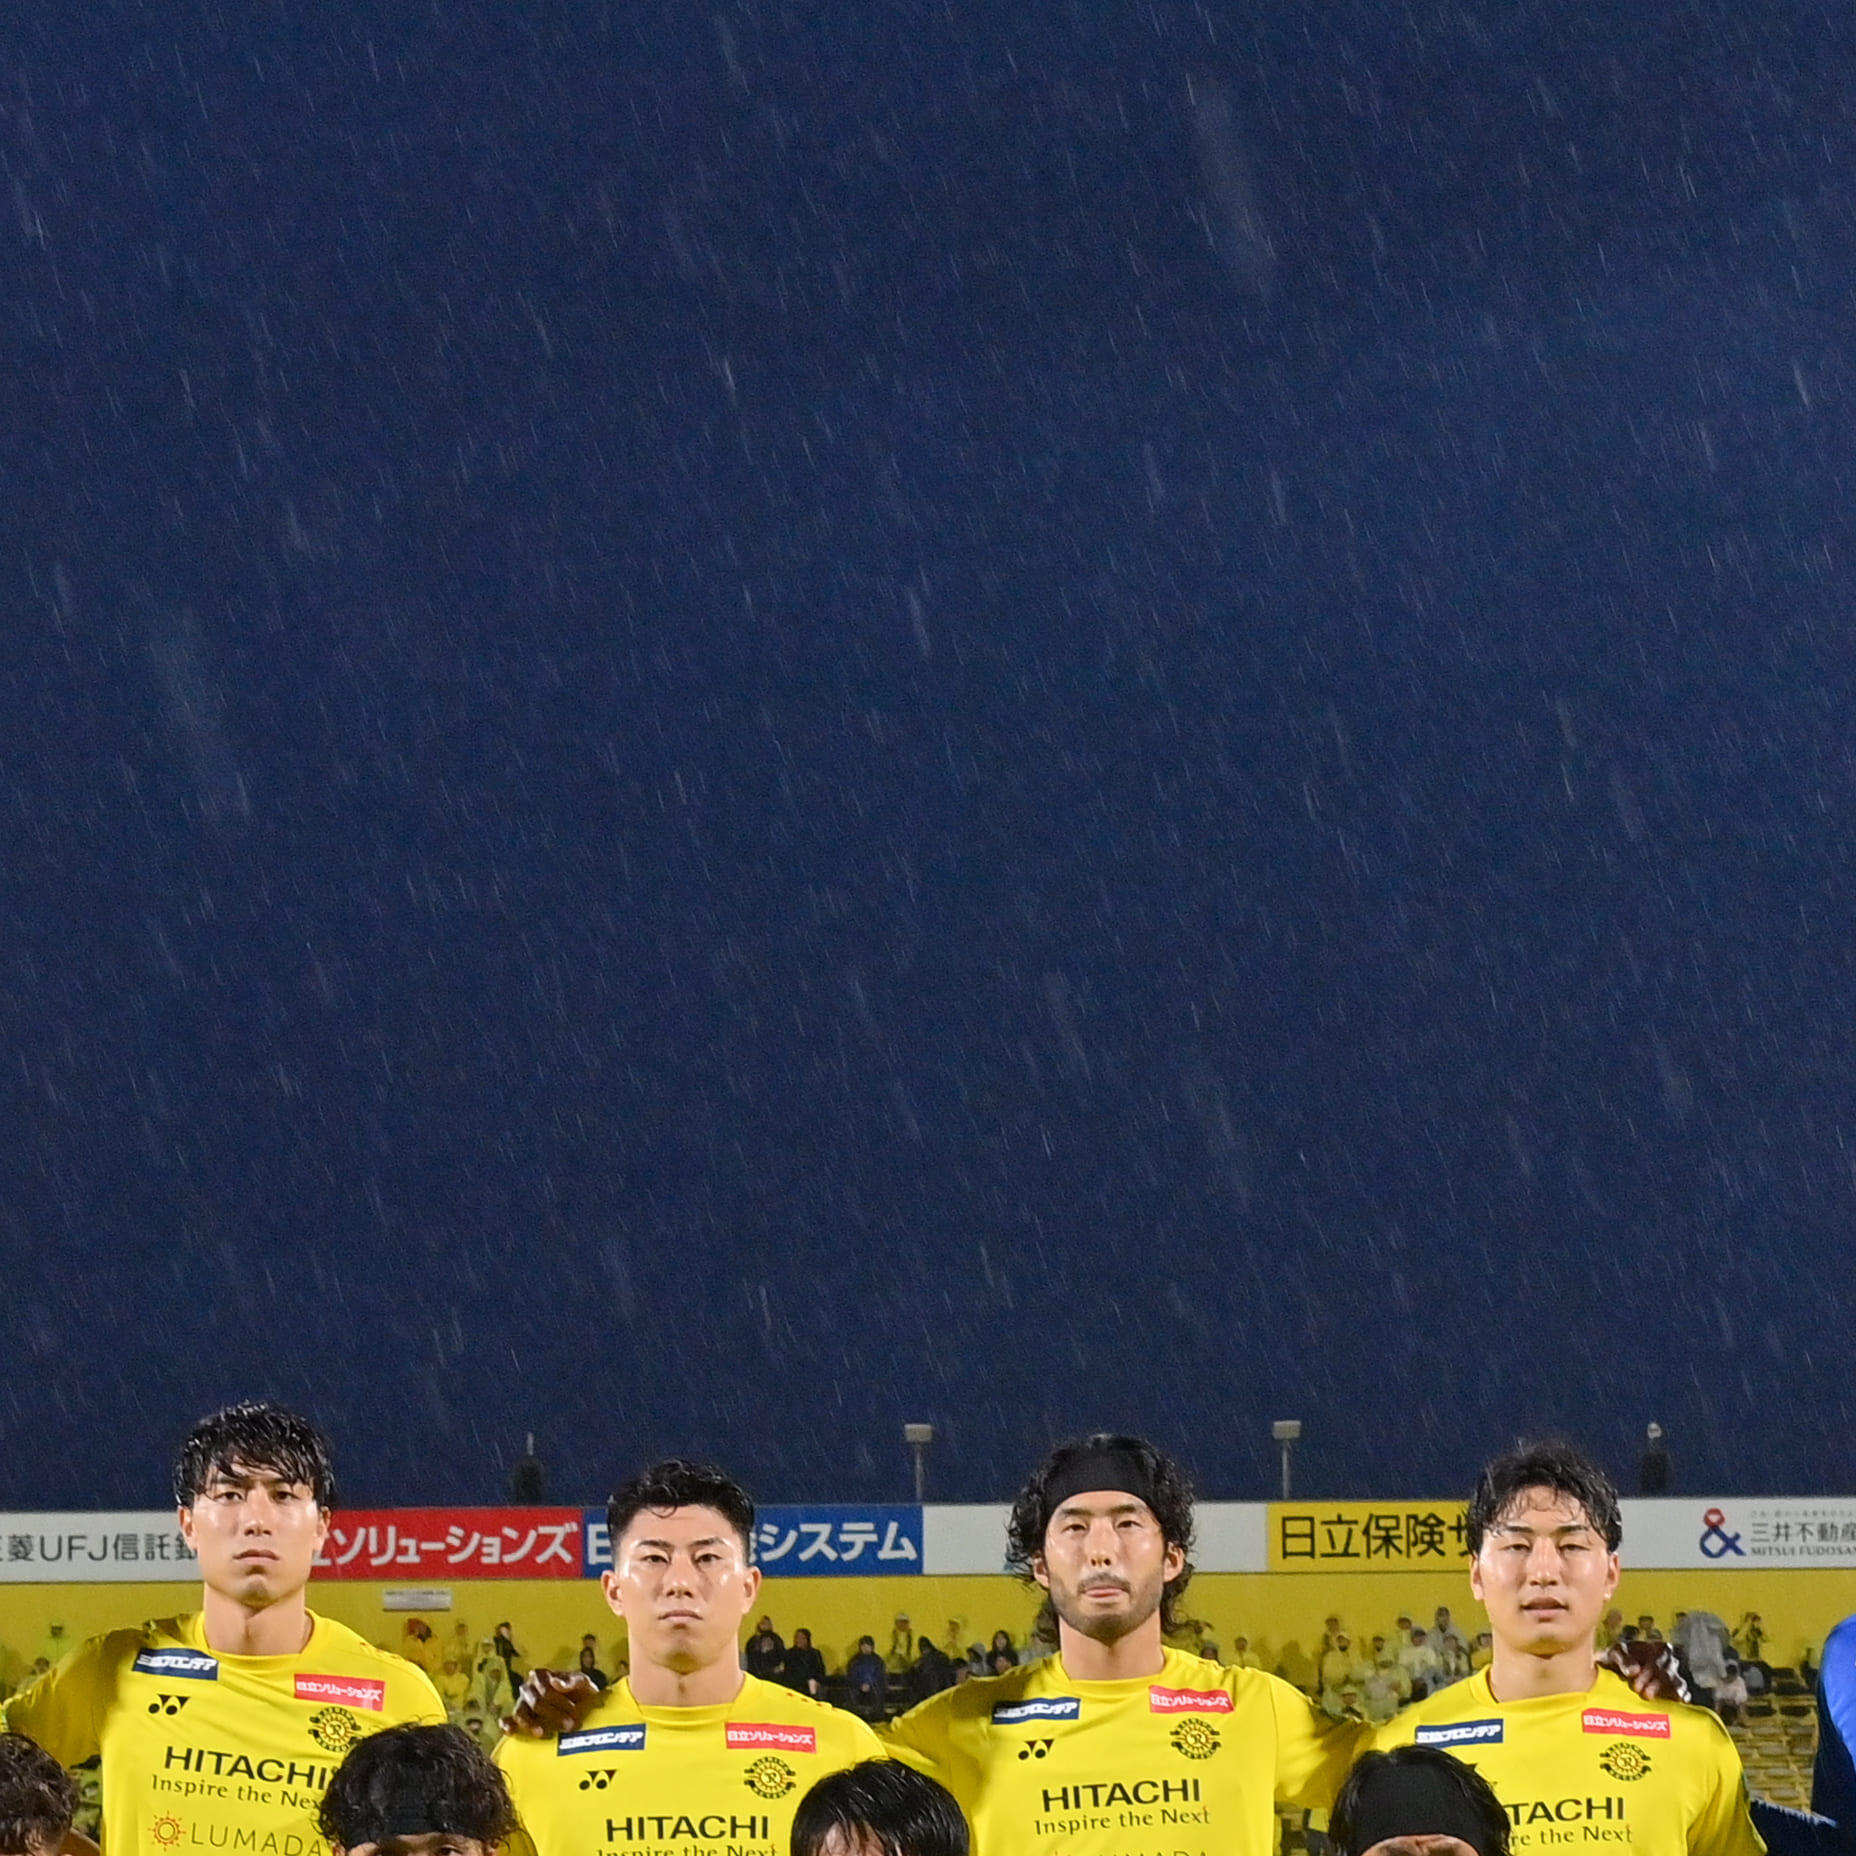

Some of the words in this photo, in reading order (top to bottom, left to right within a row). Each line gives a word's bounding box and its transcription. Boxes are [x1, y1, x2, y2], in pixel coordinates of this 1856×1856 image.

[1750, 1546, 1796, 1557] MITSUI
[164, 1745, 328, 1790] HITACHI
[151, 1774, 228, 1799] Inspire
[237, 1785, 273, 1805] the
[280, 1789, 326, 1809] Nex
[1041, 1778, 1201, 1812] HITACHI
[1034, 1815, 1111, 1836] Inspire
[1119, 1810, 1153, 1827] the
[1162, 1806, 1211, 1826] Next
[1507, 1797, 1625, 1826] TACHI
[605, 1815, 769, 1842] HITACHI
[1540, 1828, 1573, 1846] the
[1583, 1825, 1633, 1844] Next
